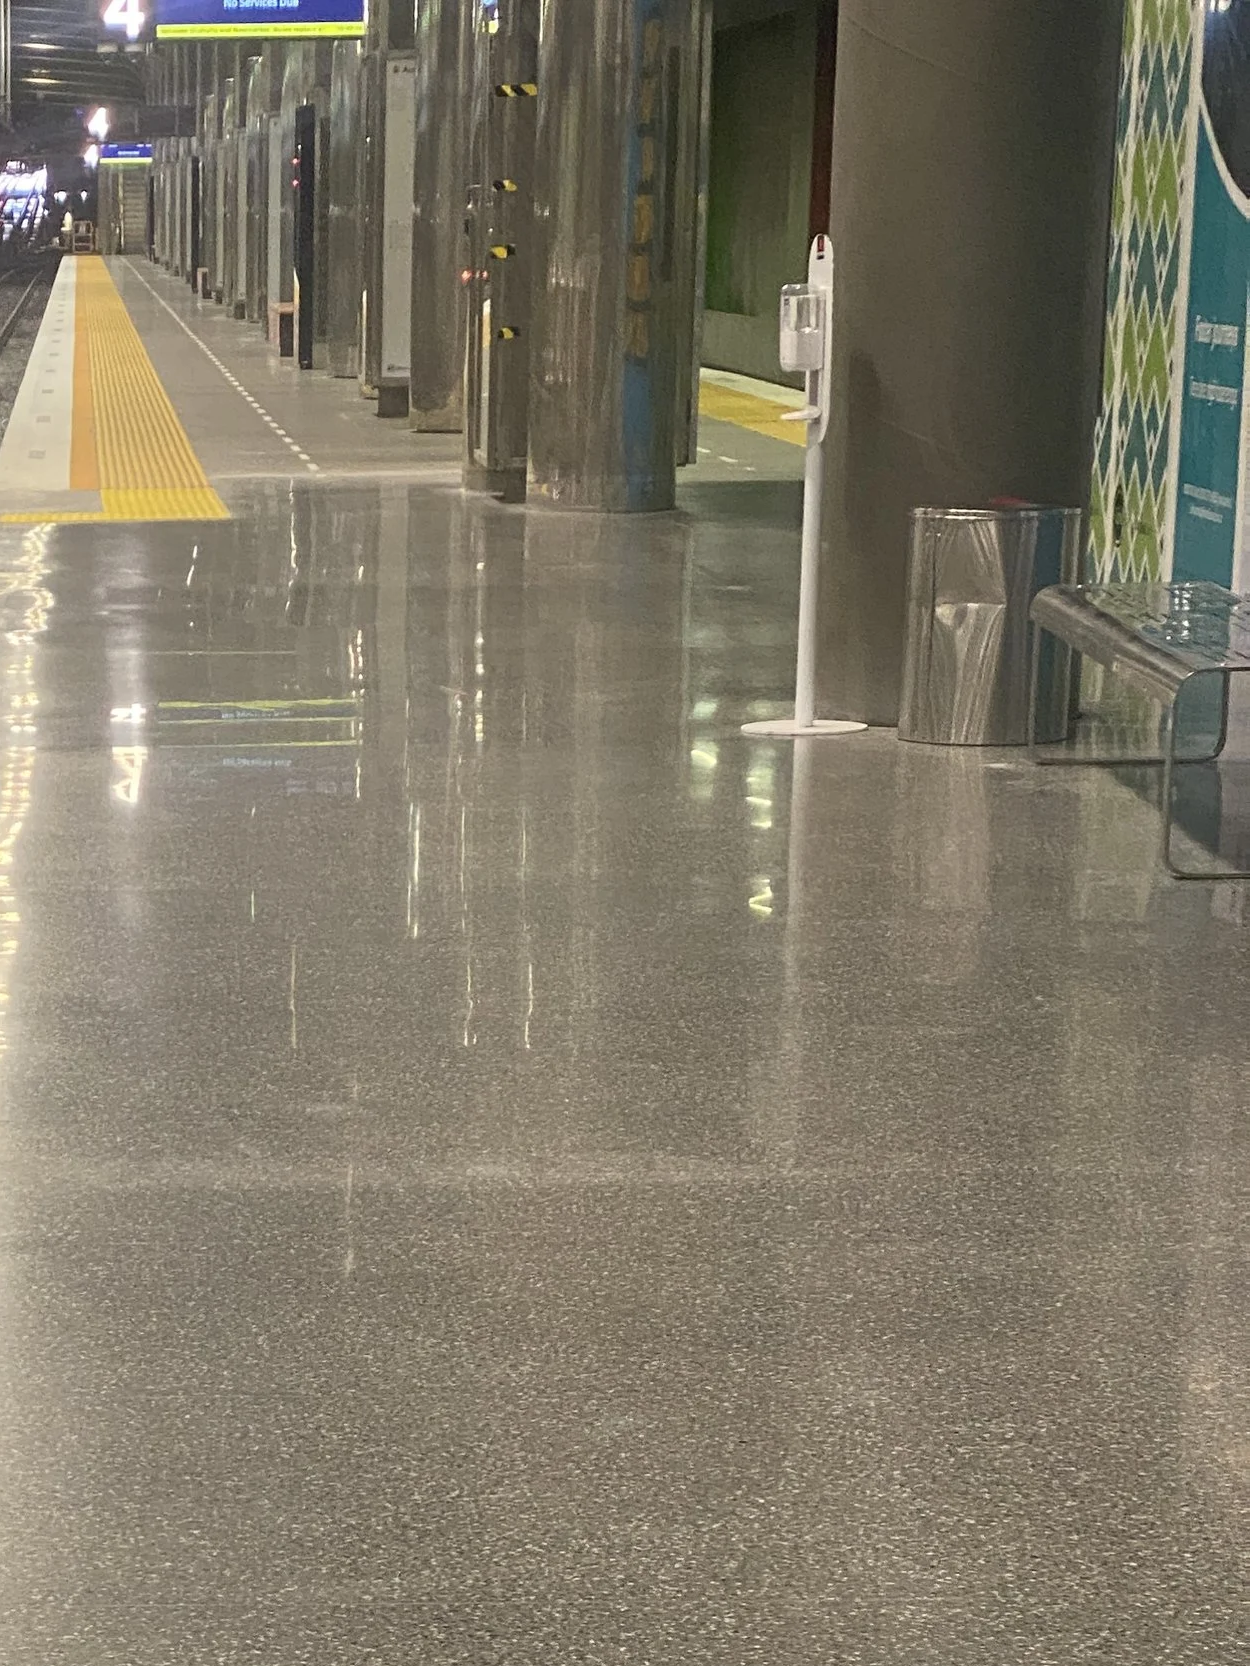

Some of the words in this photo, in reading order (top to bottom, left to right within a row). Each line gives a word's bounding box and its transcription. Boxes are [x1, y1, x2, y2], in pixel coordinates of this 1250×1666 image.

[223, 0, 238, 8] No
[239, 0, 278, 8] Services
[103, 0, 145, 39] 4
